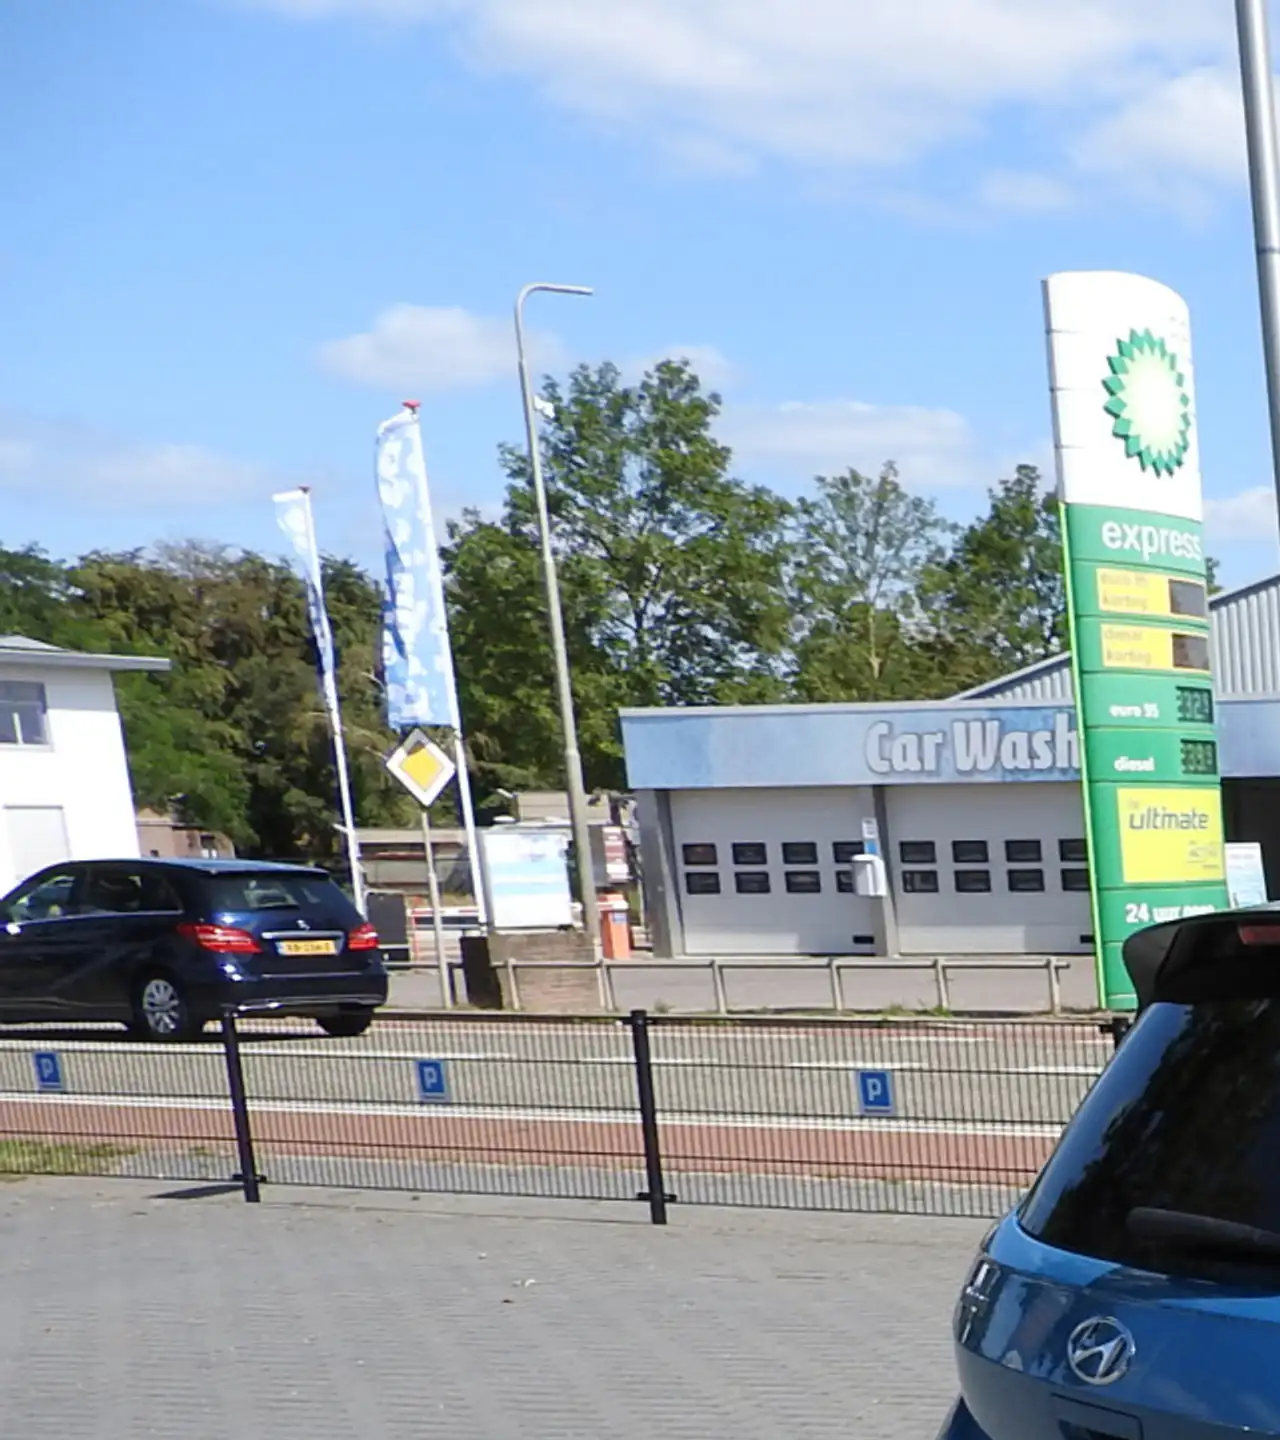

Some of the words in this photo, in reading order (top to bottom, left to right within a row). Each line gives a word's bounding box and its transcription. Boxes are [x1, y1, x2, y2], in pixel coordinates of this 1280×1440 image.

[1101, 520, 1202, 562] express
[864, 719, 945, 774] Car
[952, 711, 1082, 774] Wash
[1128, 805, 1210, 831] ultimate
[1125, 902, 1150, 924] 24
[423, 1066, 438, 1090] P
[865, 1077, 882, 1102] P
